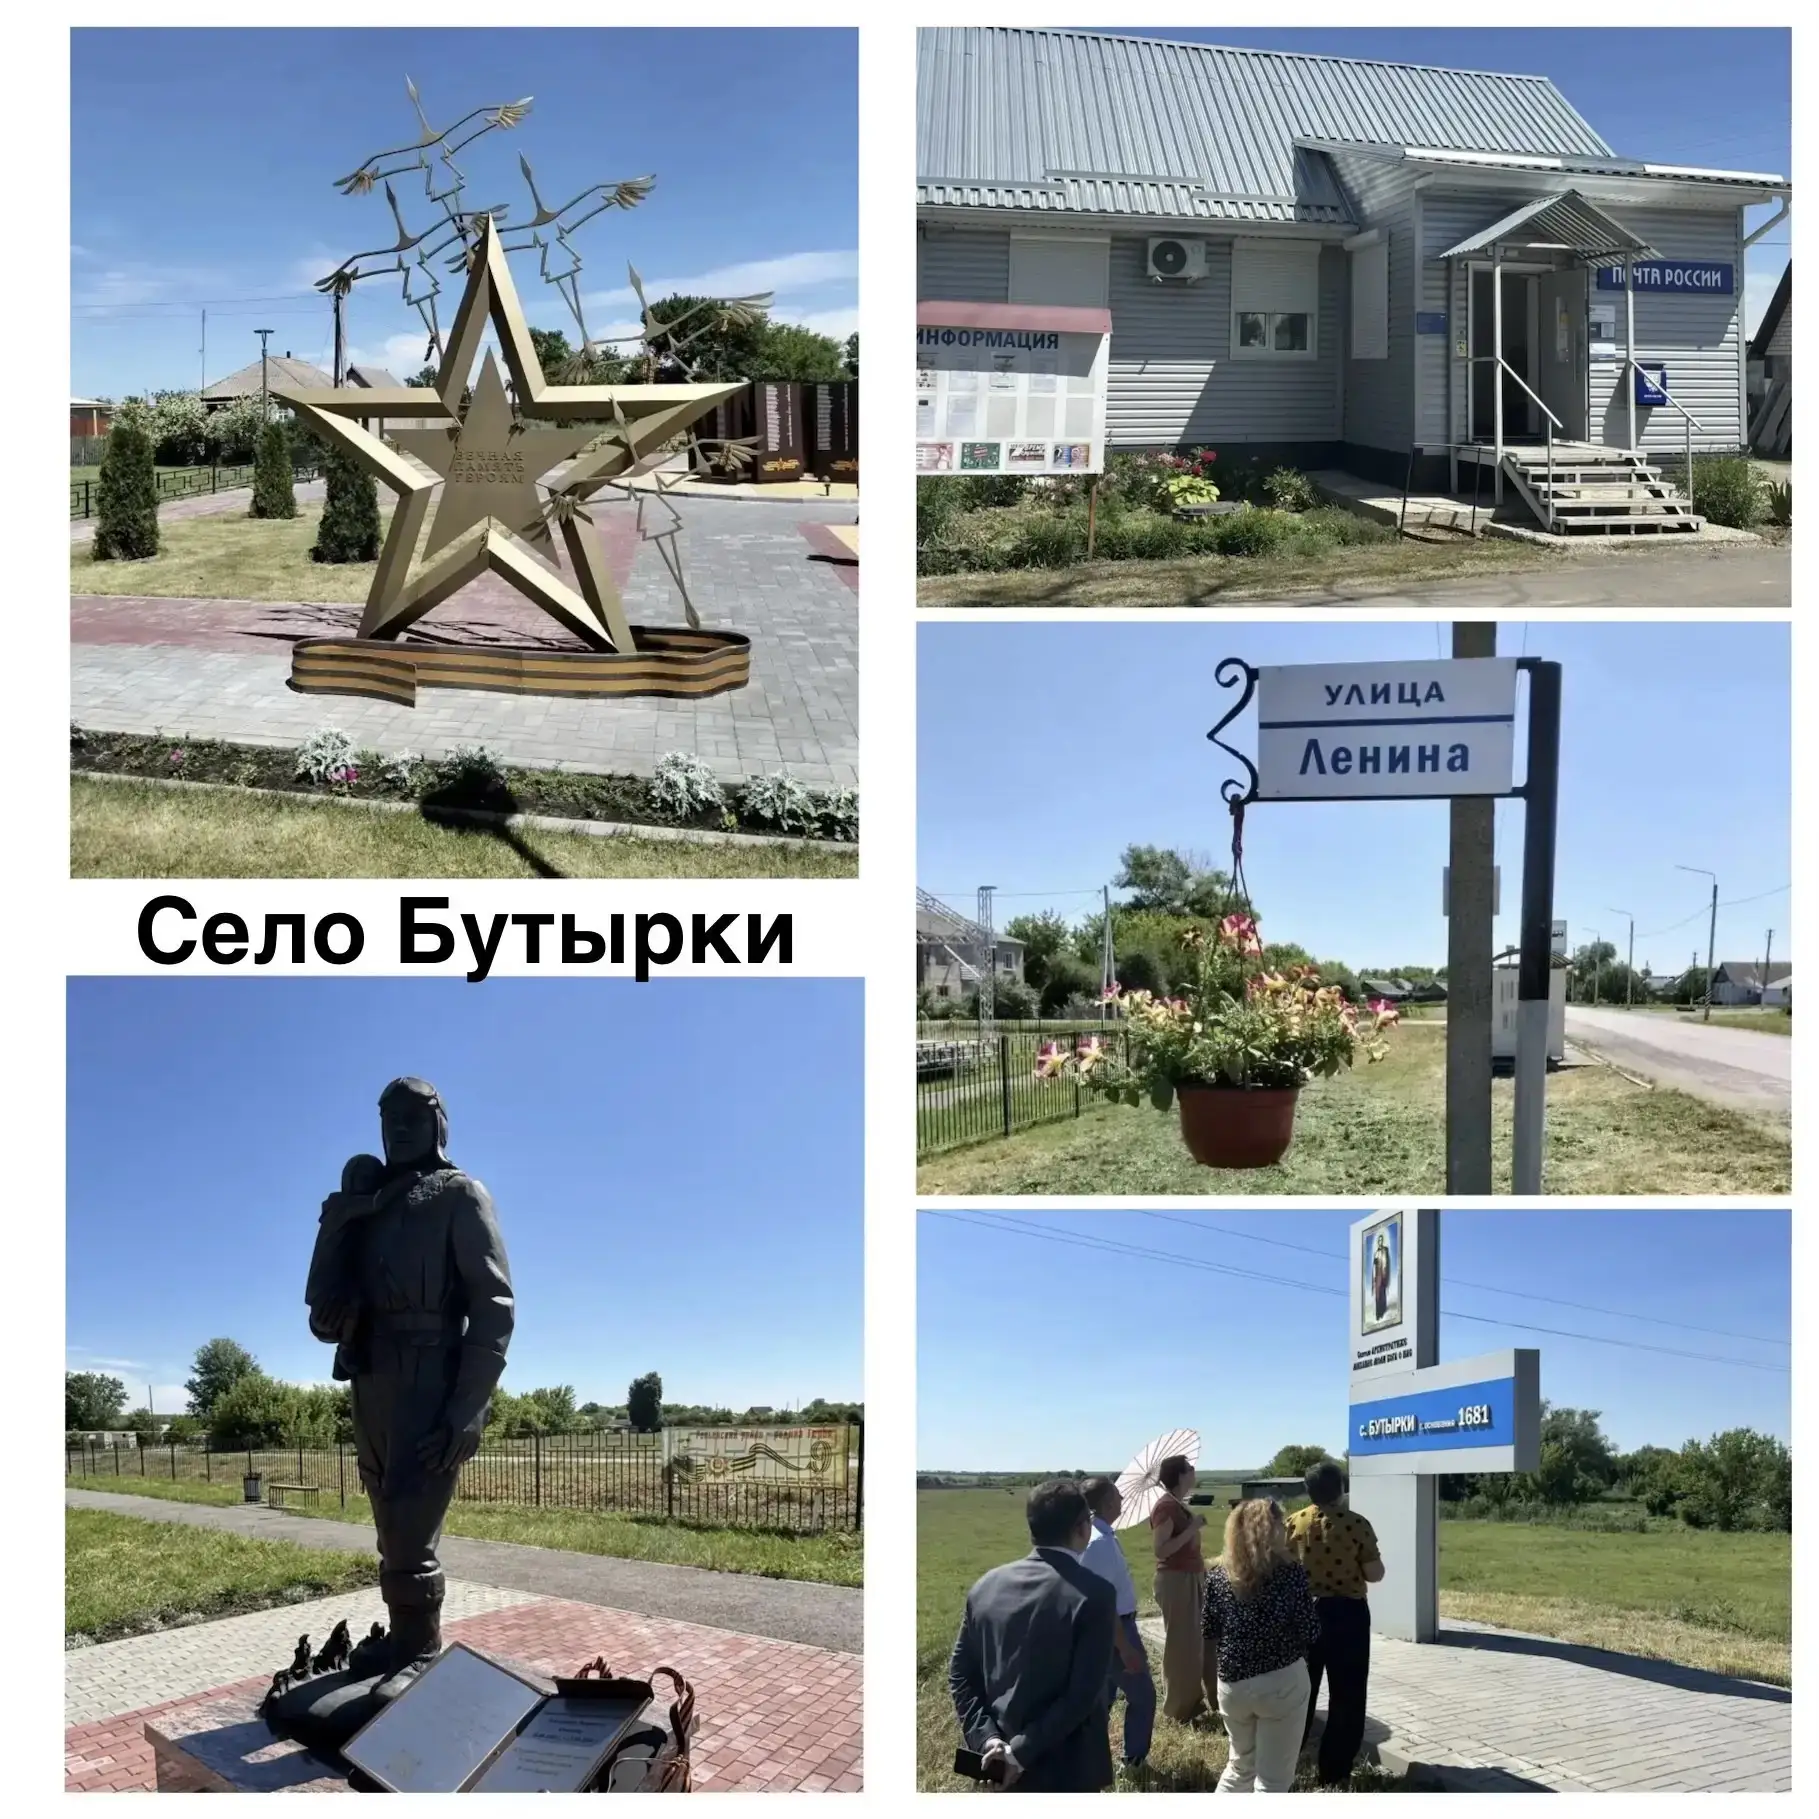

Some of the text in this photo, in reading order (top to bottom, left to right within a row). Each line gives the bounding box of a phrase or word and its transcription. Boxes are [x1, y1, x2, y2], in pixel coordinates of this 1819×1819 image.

[1665, 268, 1722, 287] РОССИИ
[455, 451, 524, 461] ВЕЧНАЯ
[454, 461, 525, 472] ПАМЯТЬ
[455, 473, 524, 483] ГЕРОЯМ
[1325, 681, 1445, 707] УЛИЦА
[1299, 738, 1469, 775] Ленина
[1368, 1415, 1415, 1437] БУТЫРКИ
[1458, 1404, 1489, 1426] 1681
